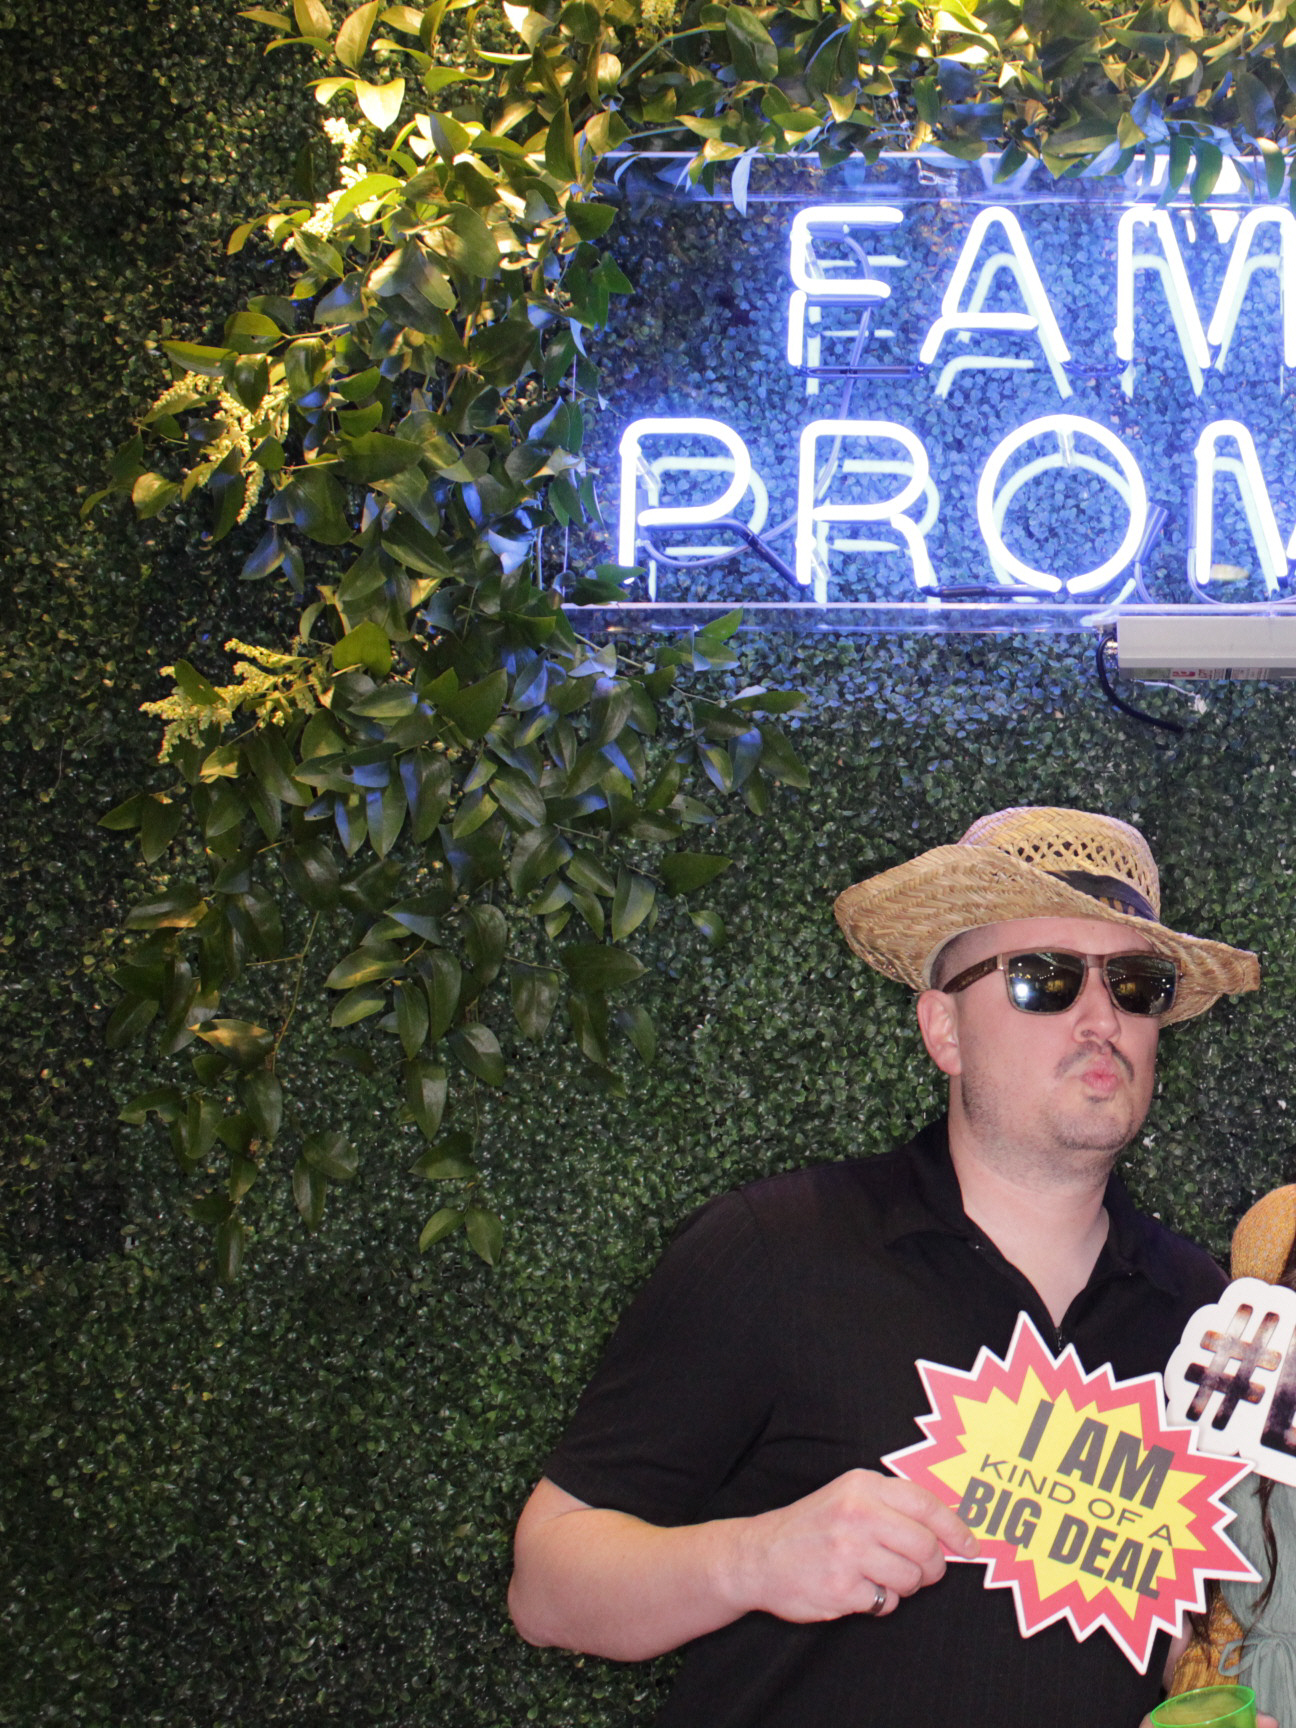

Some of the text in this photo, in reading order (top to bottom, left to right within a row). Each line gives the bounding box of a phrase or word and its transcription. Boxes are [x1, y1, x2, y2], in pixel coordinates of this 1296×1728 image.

[980, 1453, 1173, 1546] KIND OF A
[1018, 1398, 1175, 1510] I AM
[956, 1476, 1163, 1600] BIG DEAL
